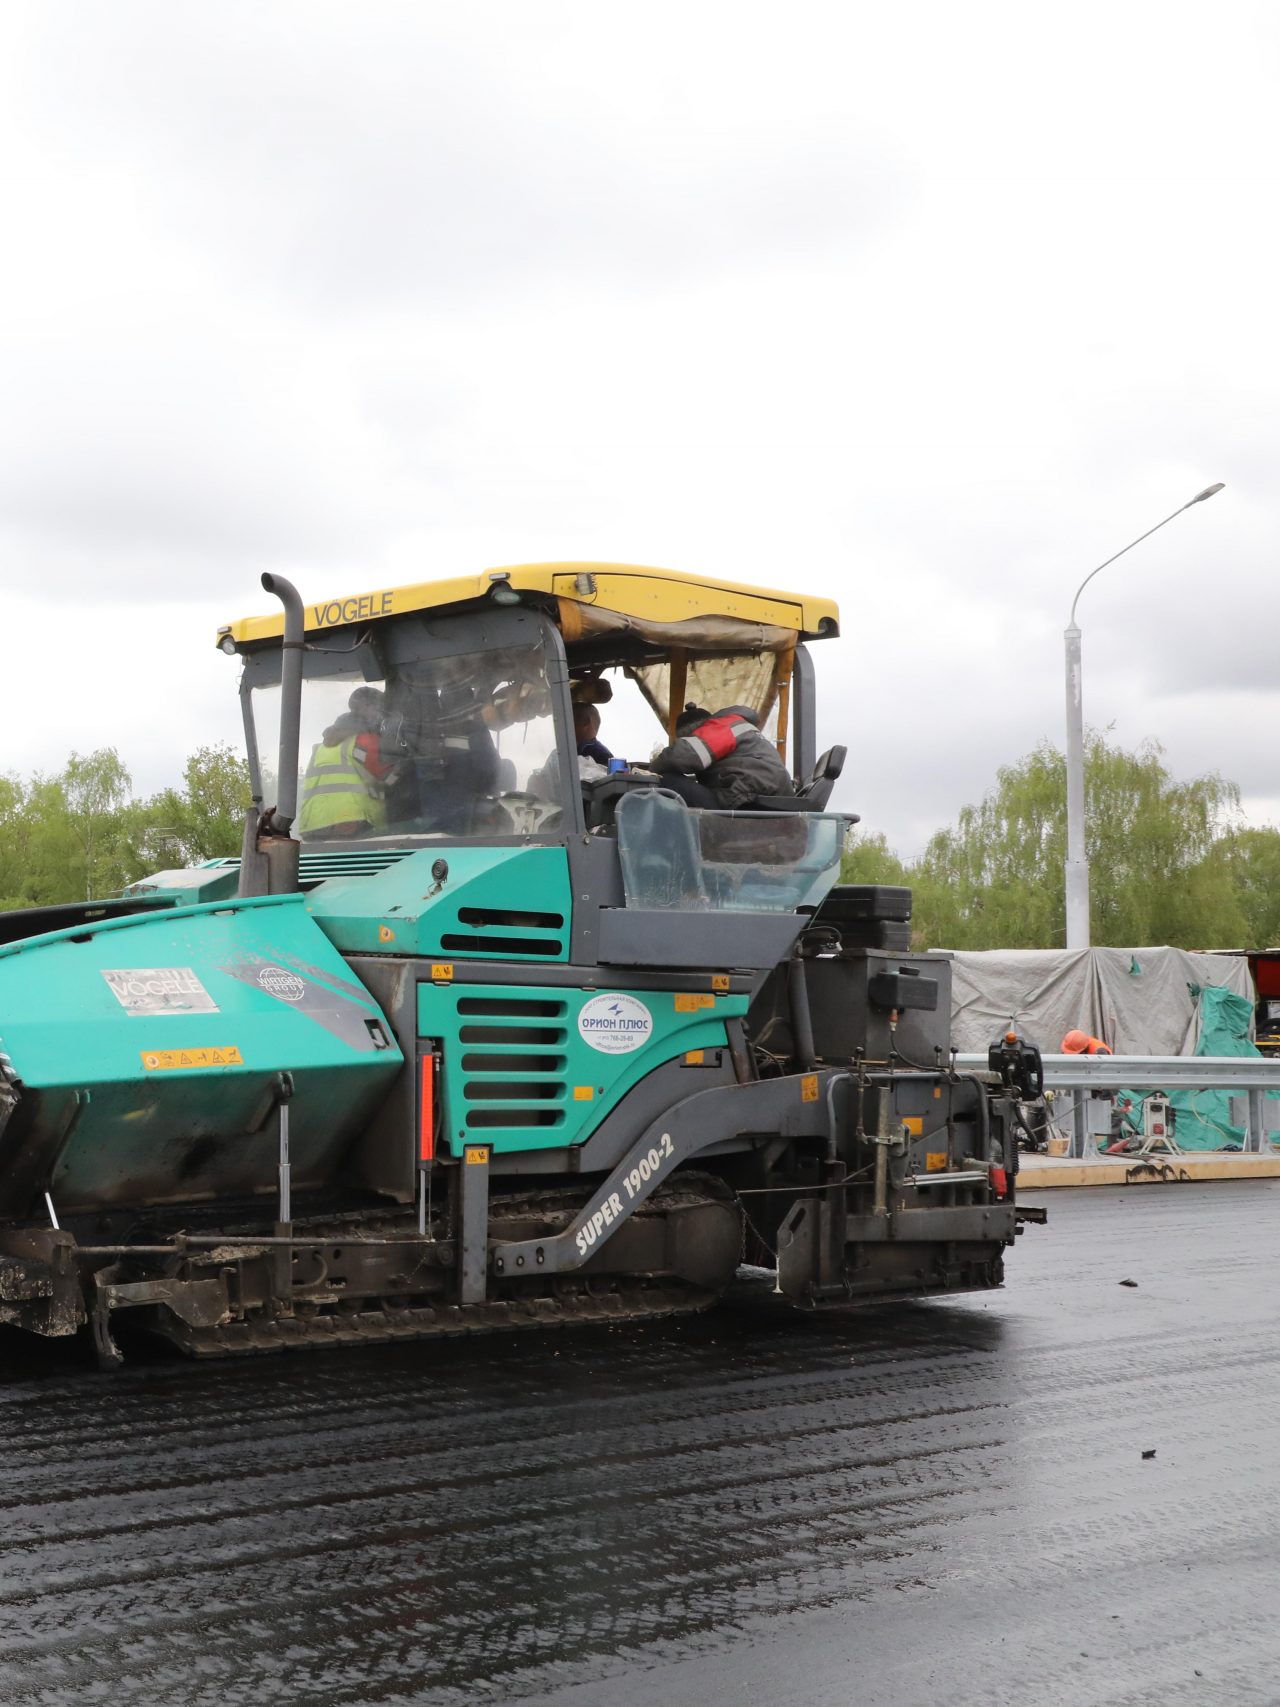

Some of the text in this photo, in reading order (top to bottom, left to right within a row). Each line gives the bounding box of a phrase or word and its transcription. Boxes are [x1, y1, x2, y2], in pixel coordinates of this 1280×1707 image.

[314, 591, 393, 626] VÖGELE
[109, 978, 205, 996] VÖGELE
[256, 976, 304, 986] WIRTGEN
[265, 984, 304, 992] GROUP
[582, 1018, 649, 1030] ОРИОН ПЛЮС
[575, 1133, 675, 1256] SUPER 1900-2
